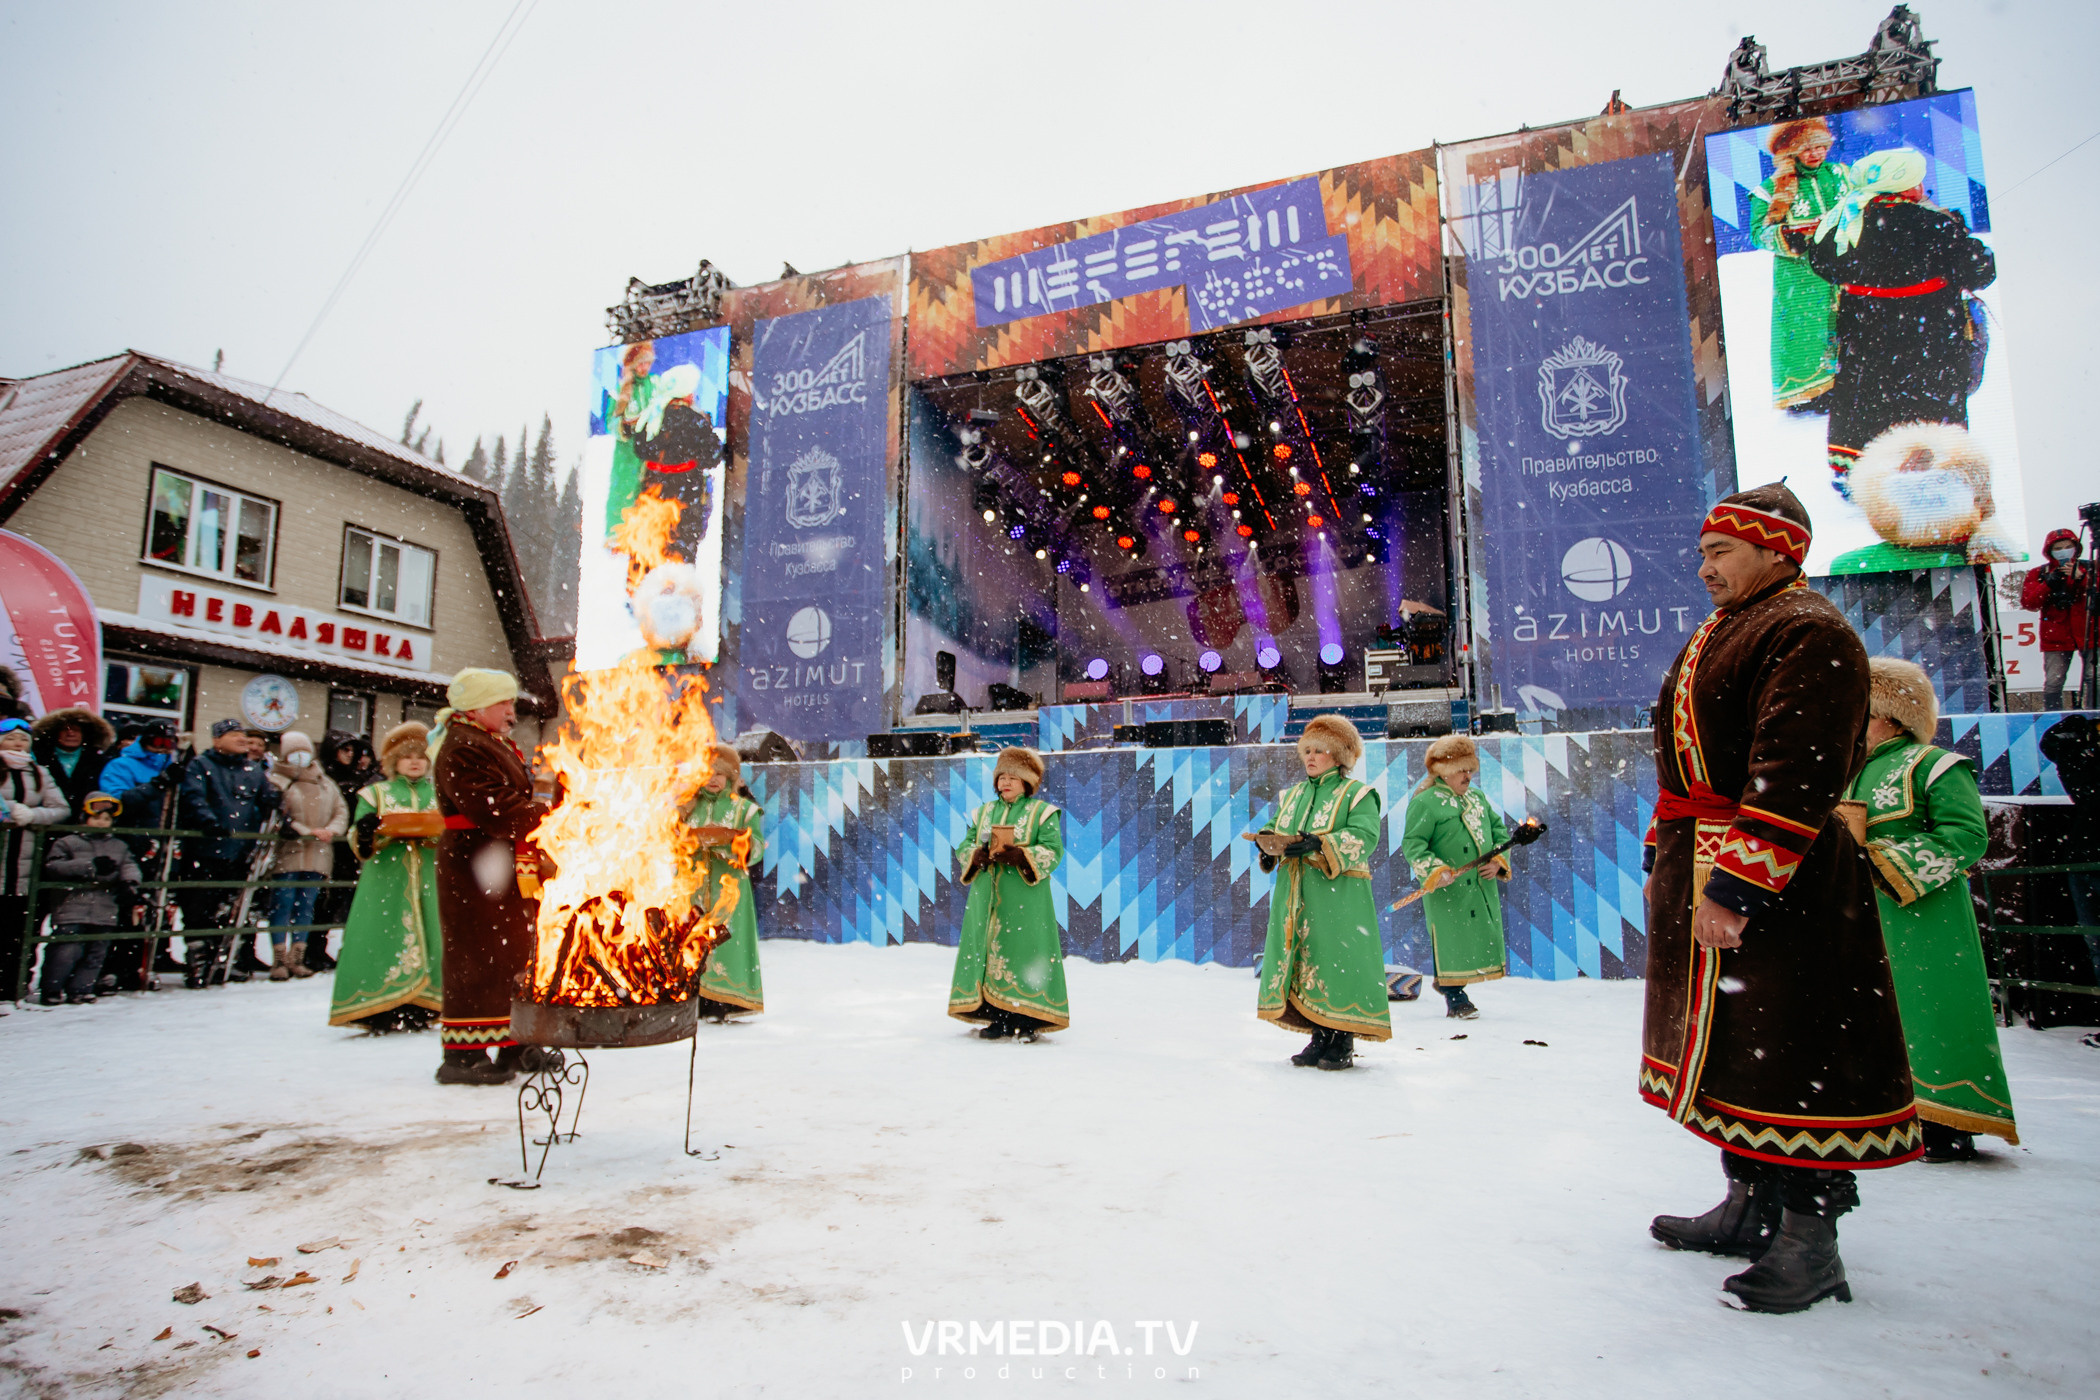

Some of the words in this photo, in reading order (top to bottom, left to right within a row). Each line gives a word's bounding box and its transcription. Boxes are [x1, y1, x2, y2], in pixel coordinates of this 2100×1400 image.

[994, 205, 1300, 312] ШЕРЕГЕШ
[1498, 243, 1562, 273] 300
[1567, 243, 1619, 266] ЛЕТ
[1499, 257, 1650, 301] КУЗБАСС
[771, 368, 815, 396] 300
[769, 381, 867, 418] КУЗБАСС
[1521, 448, 1657, 477] Правительство
[1549, 477, 1632, 502] Кузбасса
[785, 559, 836, 578] Кузбасса
[171, 590, 413, 660] НЕВАЛЯШКА
[1566, 645, 1640, 662] HOTELS
[784, 692, 830, 708] HOTELS
